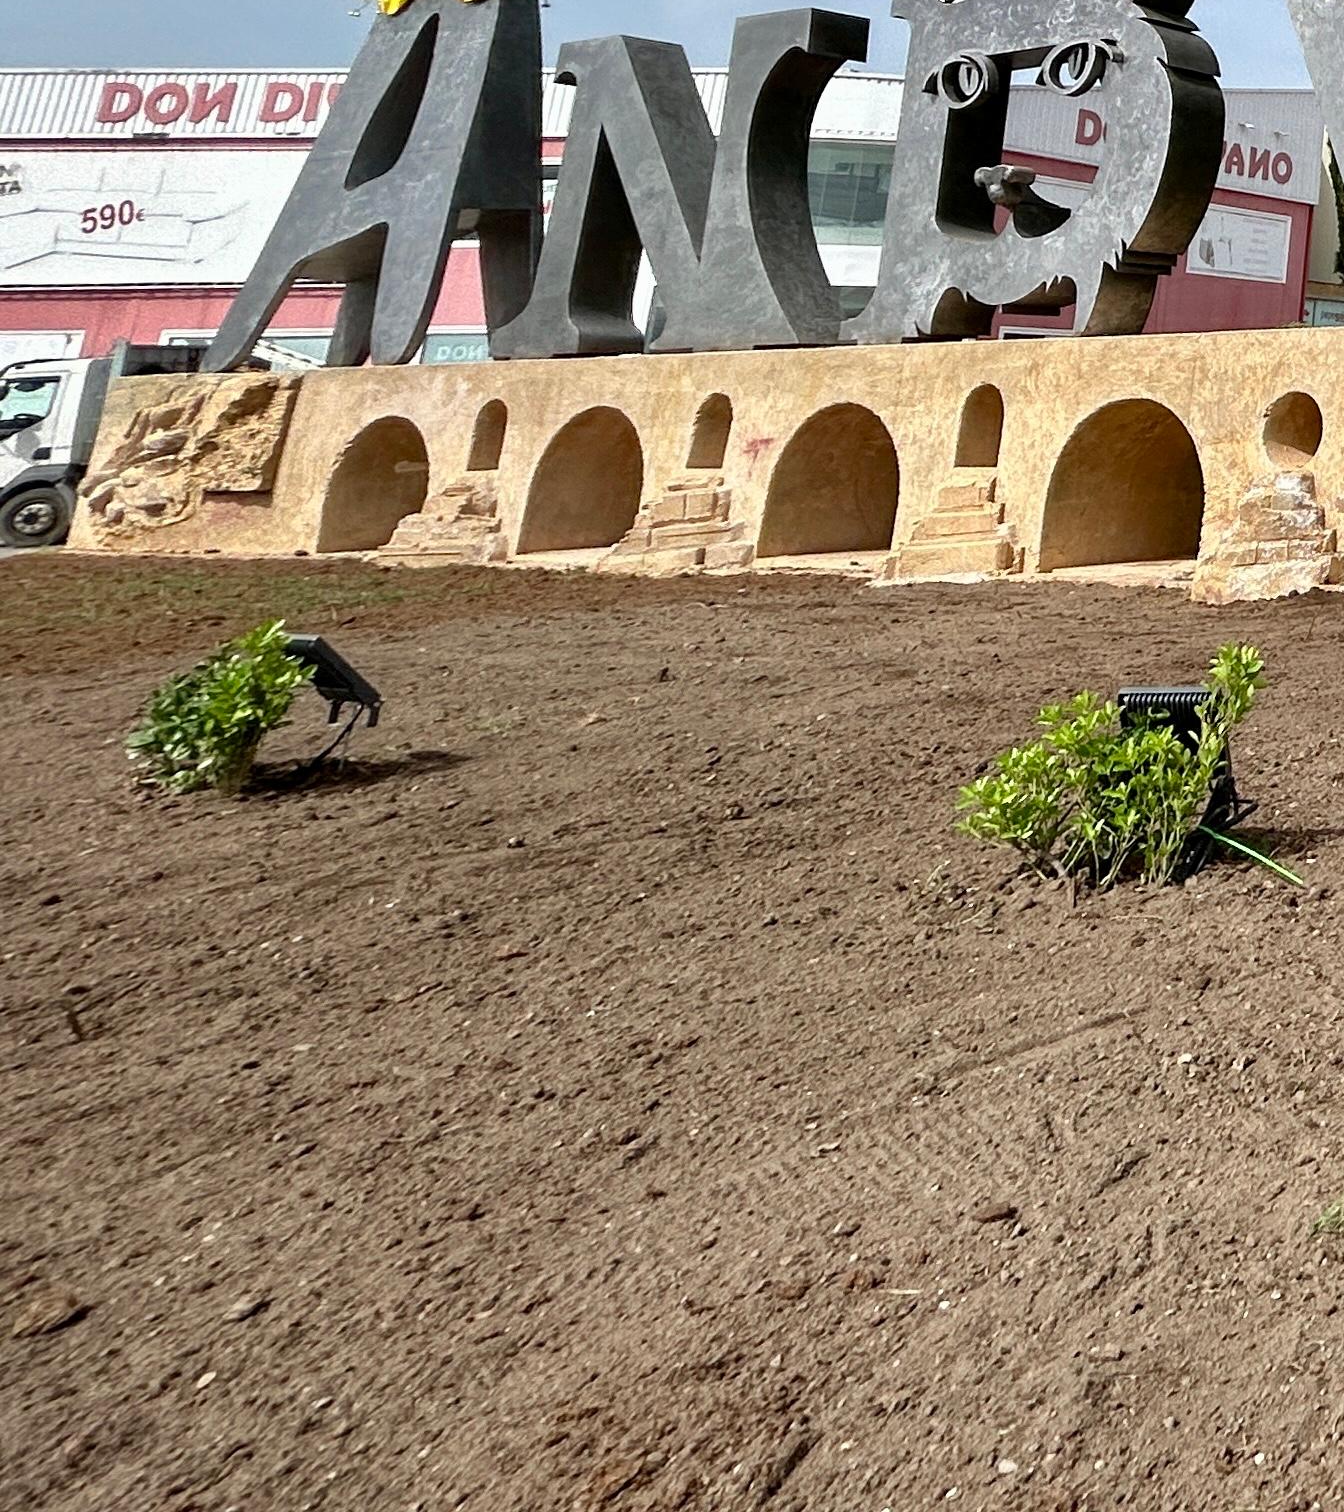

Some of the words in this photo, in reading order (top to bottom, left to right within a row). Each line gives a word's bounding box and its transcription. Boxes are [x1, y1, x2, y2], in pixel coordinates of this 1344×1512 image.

[95, 81, 239, 125] DON
[1221, 140, 1293, 185] ANO
[80, 199, 146, 235] 590€
